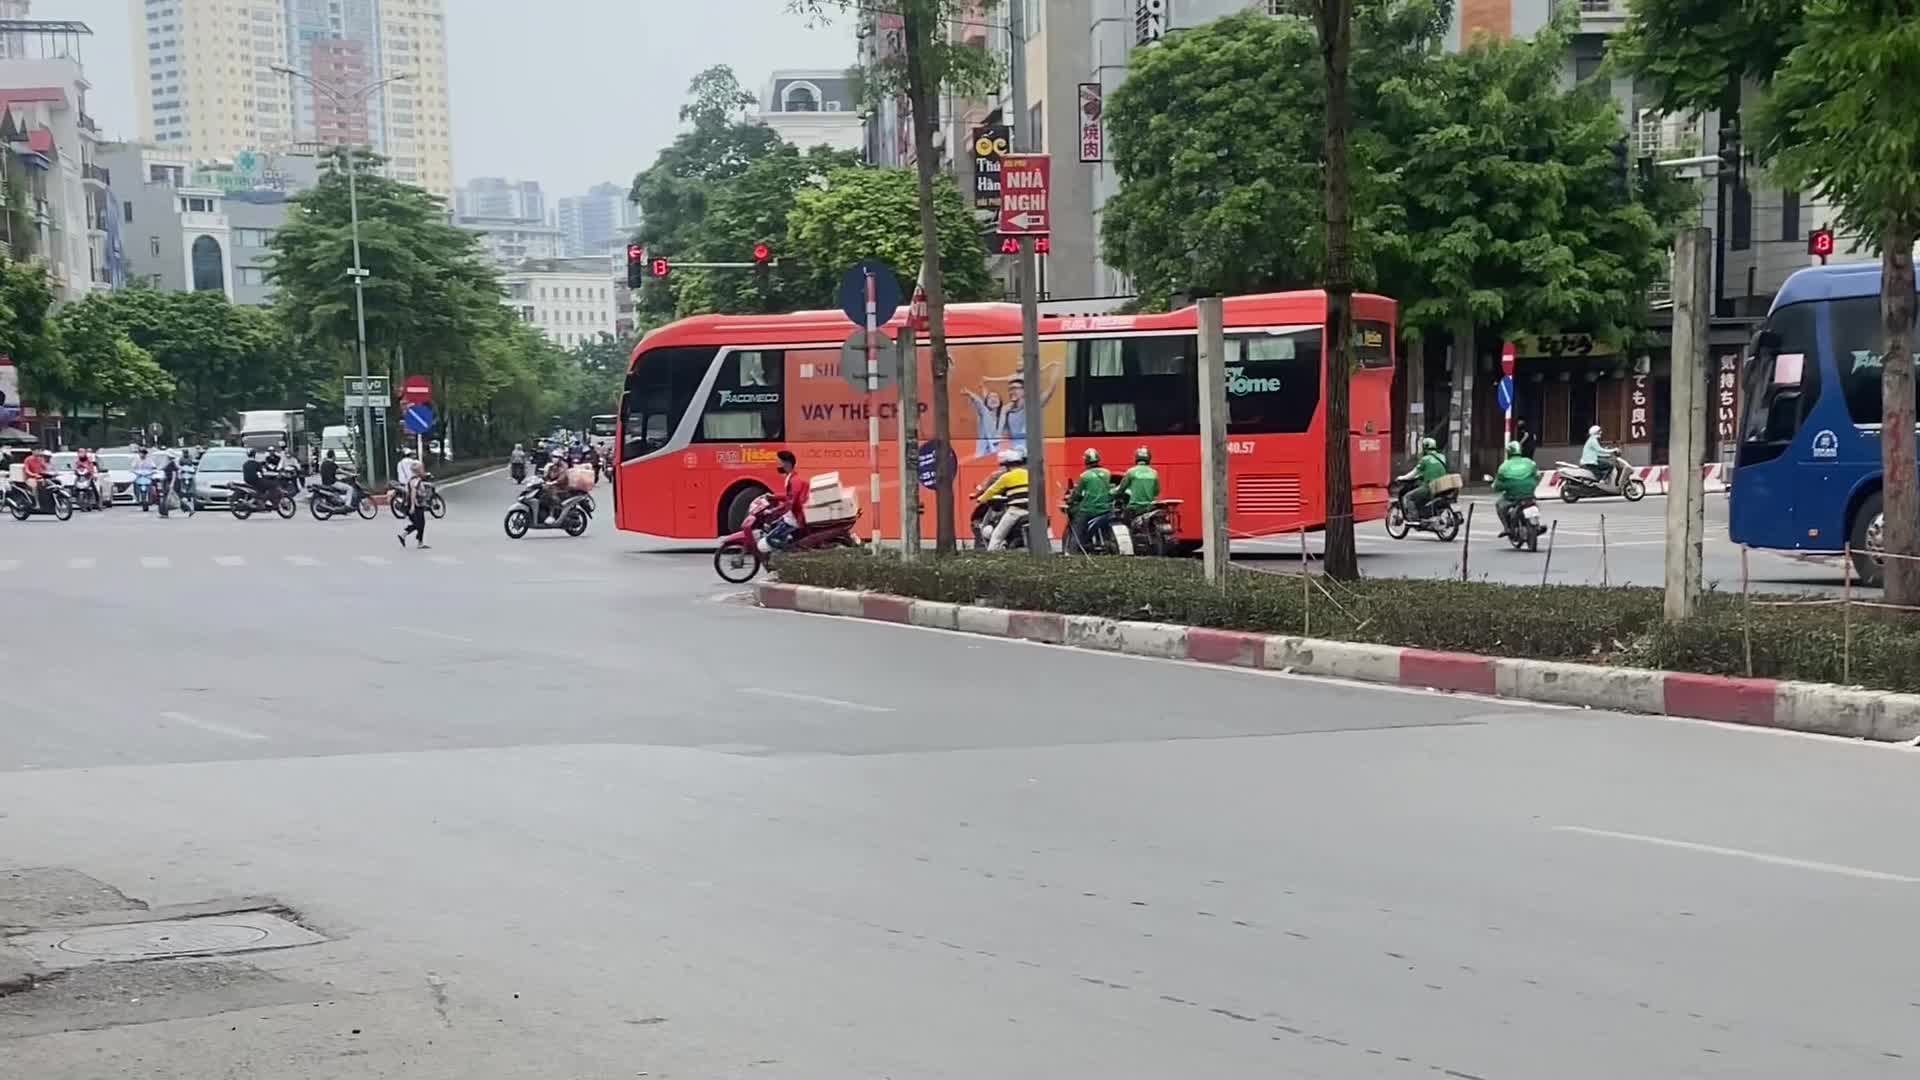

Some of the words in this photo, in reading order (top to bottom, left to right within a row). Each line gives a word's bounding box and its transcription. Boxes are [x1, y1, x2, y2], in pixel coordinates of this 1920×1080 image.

[1006, 168, 1044, 189] NHÀ
[1003, 189, 1046, 211] NGHỈ
[802, 403, 834, 420] VAY
[1226, 441, 1256, 454] 40.57
